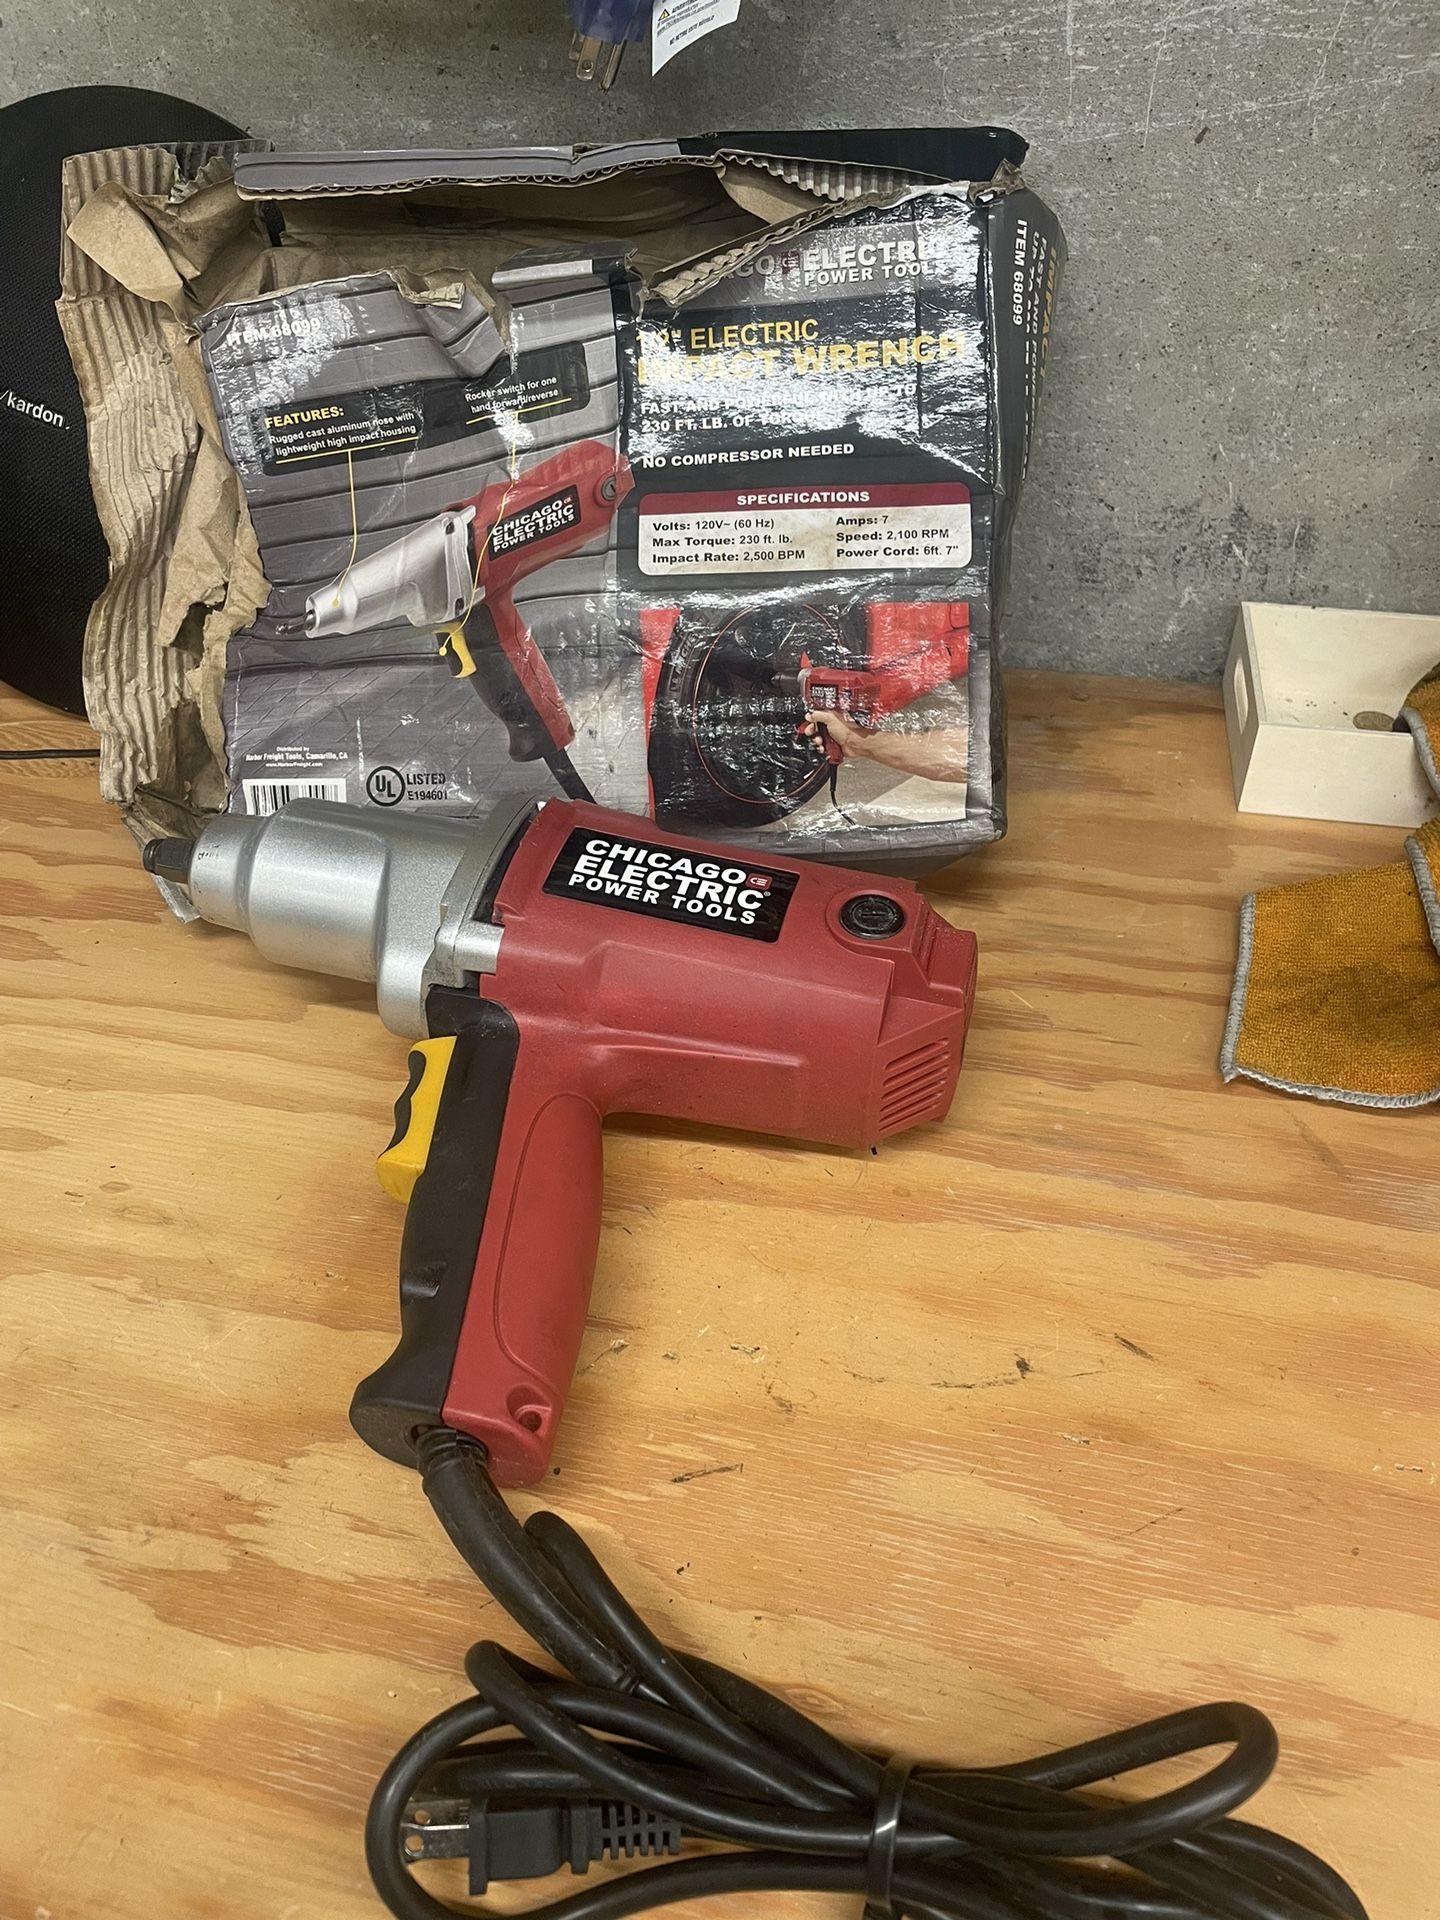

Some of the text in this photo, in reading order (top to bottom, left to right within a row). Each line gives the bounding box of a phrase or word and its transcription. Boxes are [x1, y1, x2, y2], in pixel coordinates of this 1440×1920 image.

[1012, 219, 1028, 326] ITEM 68099
[1035, 237, 1048, 289] FAST
[804, 269, 873, 286] POWER
[1032, 291, 1040, 335] AND
[226, 317, 321, 347] ITEM 68099
[690, 319, 819, 349] ELECTRIC
[792, 332, 966, 375] WRENCH
[465, 376, 557, 402] Rocker switch for one
[471, 389, 559, 414] hand forward/reverse
[264, 406, 345, 429] FEATURES:
[640, 401, 681, 415] FAST
[269, 411, 415, 445] Rugged cast aluminum nose with
[641, 419, 670, 433] 230
[675, 418, 698, 431] FT.
[702, 416, 728, 430] LB.
[732, 414, 752, 428] OF
[276, 424, 417, 456] lightweight high impact housing
[643, 443, 855, 469] NO COMPRESSOR NEEDED
[737, 491, 871, 506] SPECIFICATIONS
[493, 500, 563, 536] CHICAGO
[493, 504, 574, 546] ELECTRIC
[653, 518, 775, 531] Volts: 120V~ (60 Hz)
[836, 515, 889, 527] Amps: 7
[493, 513, 575, 553] POWER TOOLS
[653, 534, 793, 548] Max Torque: 230 ft. lb.
[836, 529, 949, 543] Speed: 2,100 RPM
[652, 550, 805, 565] Impact Rate: 2,500 BPM
[836, 545, 959, 558] Power Cord: 6ft. 7"
[339, 752, 348, 760] CA
[375, 774, 397, 798] UL
[406, 773, 446, 785] LISTED
[408, 790, 448, 800] E194601
[585, 839, 747, 885] CHICAGO
[568, 873, 756, 925] POWER TOOLS
